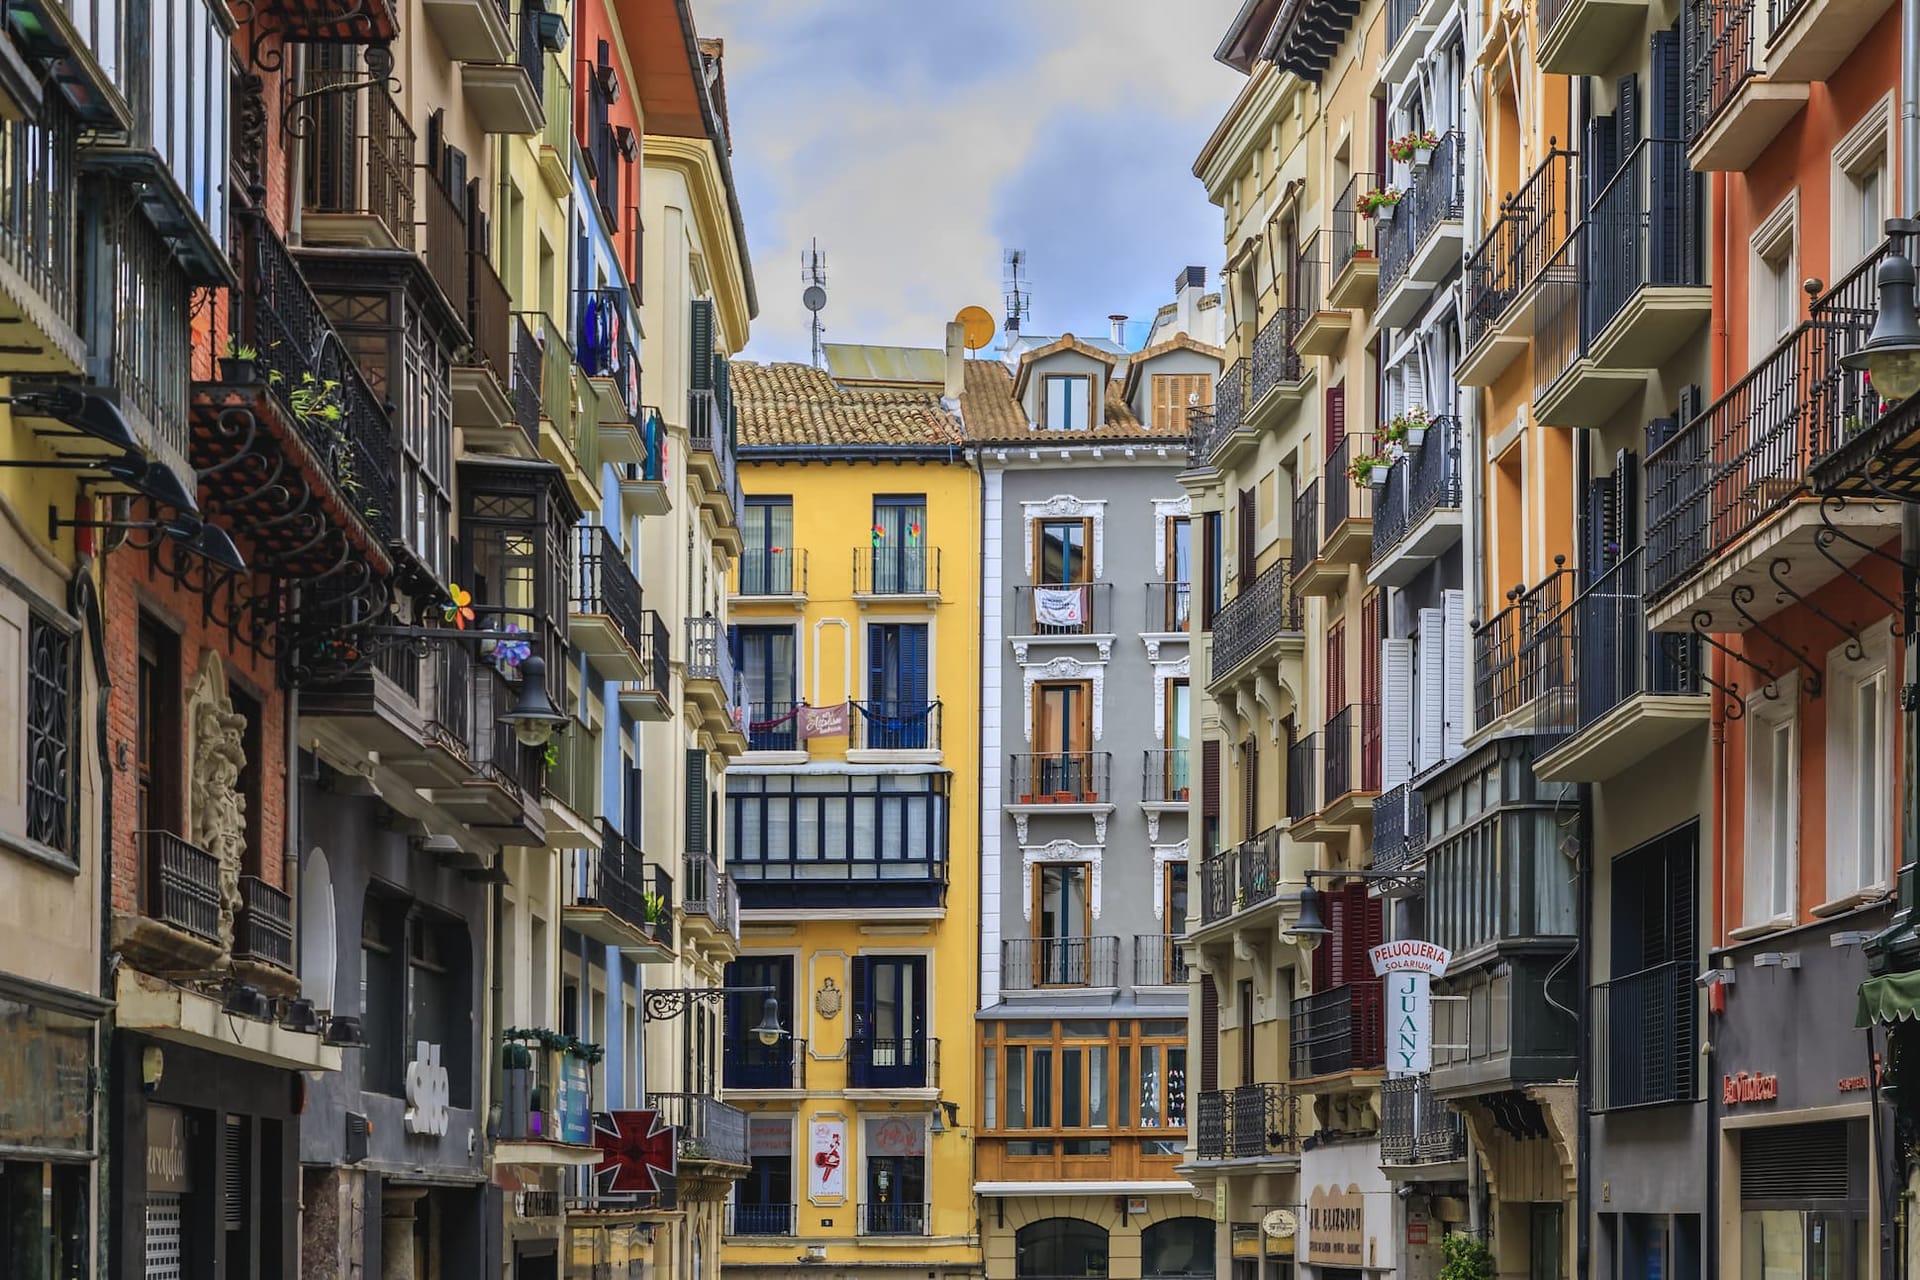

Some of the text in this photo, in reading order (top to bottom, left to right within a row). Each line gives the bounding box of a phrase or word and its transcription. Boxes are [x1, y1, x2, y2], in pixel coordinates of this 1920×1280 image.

[1374, 942, 1445, 964] PELUQUERIA
[1385, 959, 1432, 972] SOLARIUM
[1398, 976, 1418, 1069] JUANY
